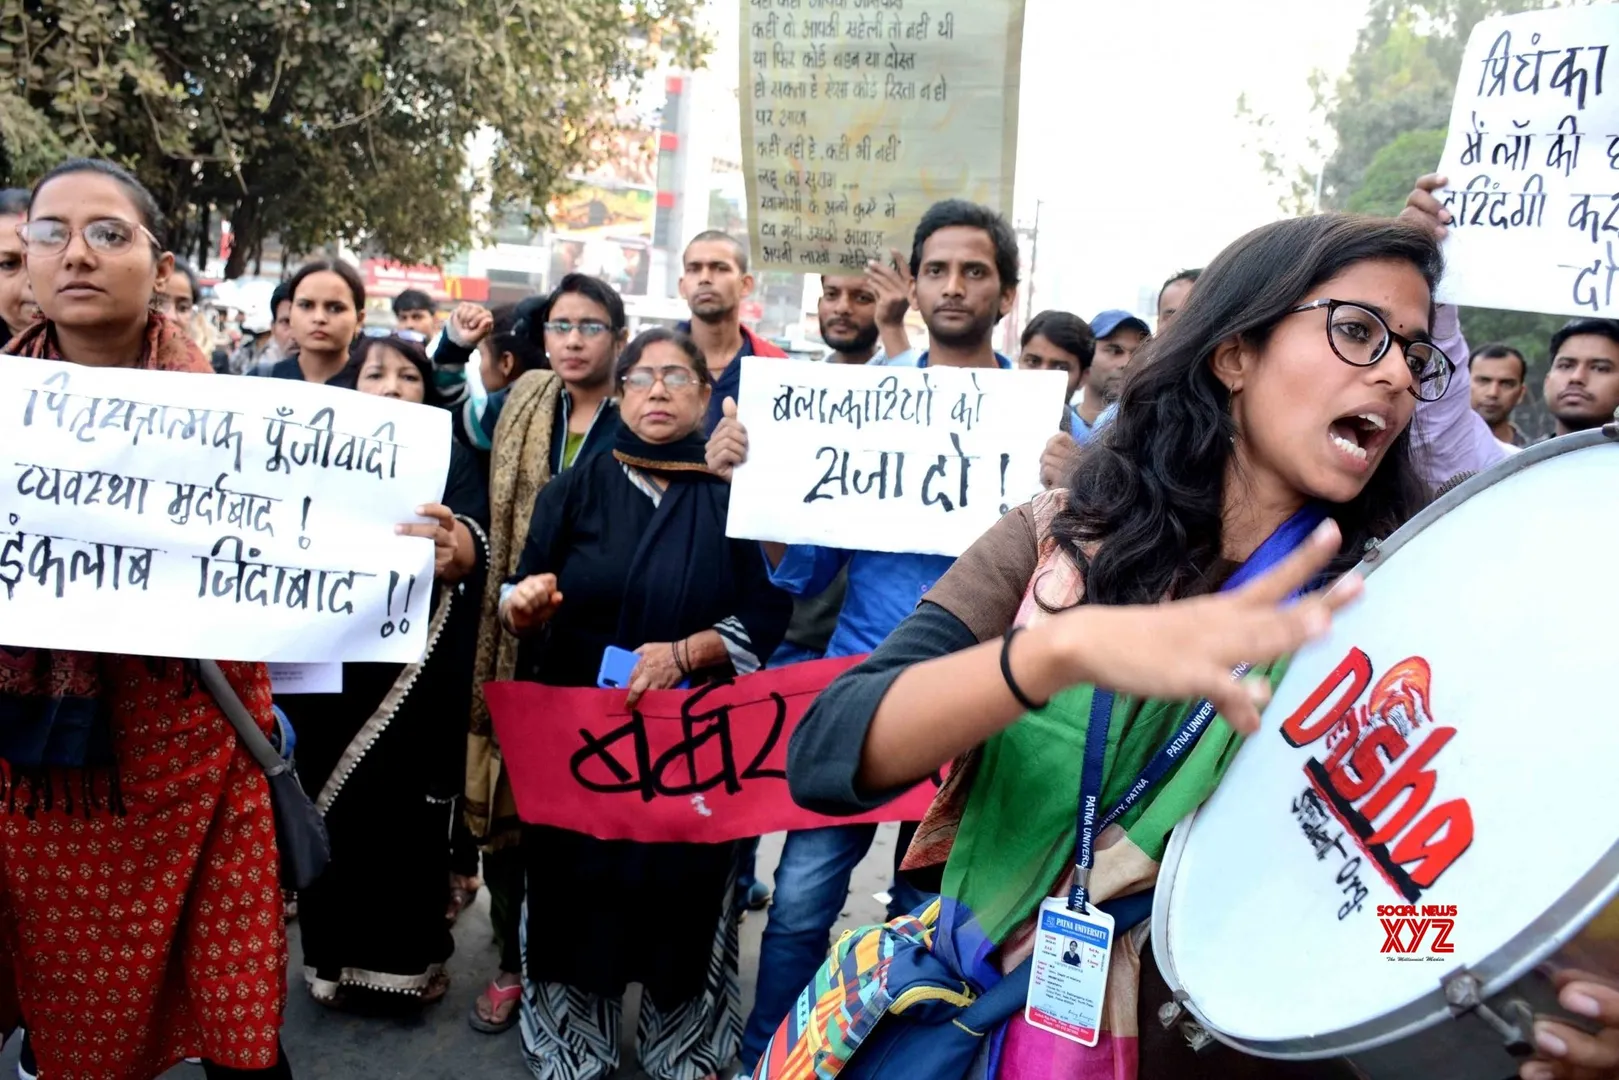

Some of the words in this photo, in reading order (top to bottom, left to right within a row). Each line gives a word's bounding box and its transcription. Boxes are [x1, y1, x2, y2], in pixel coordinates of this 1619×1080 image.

[1546, 115, 1585, 177] की
[950, 373, 990, 430] को
[15, 462, 154, 514] व्यवस्था
[921, 432, 980, 513] दो
[1229, 659, 1250, 684] ATNA
[1166, 729, 1192, 758] PATNA
[1188, 702, 1215, 733] UNIVER
[1084, 795, 1096, 826] PATNA
[1125, 778, 1149, 805] PATNA
[1081, 826, 1092, 868] UNIVERS
[1056, 917, 1073, 930] PATNA
[1074, 923, 1107, 940] UNIVERSITY
